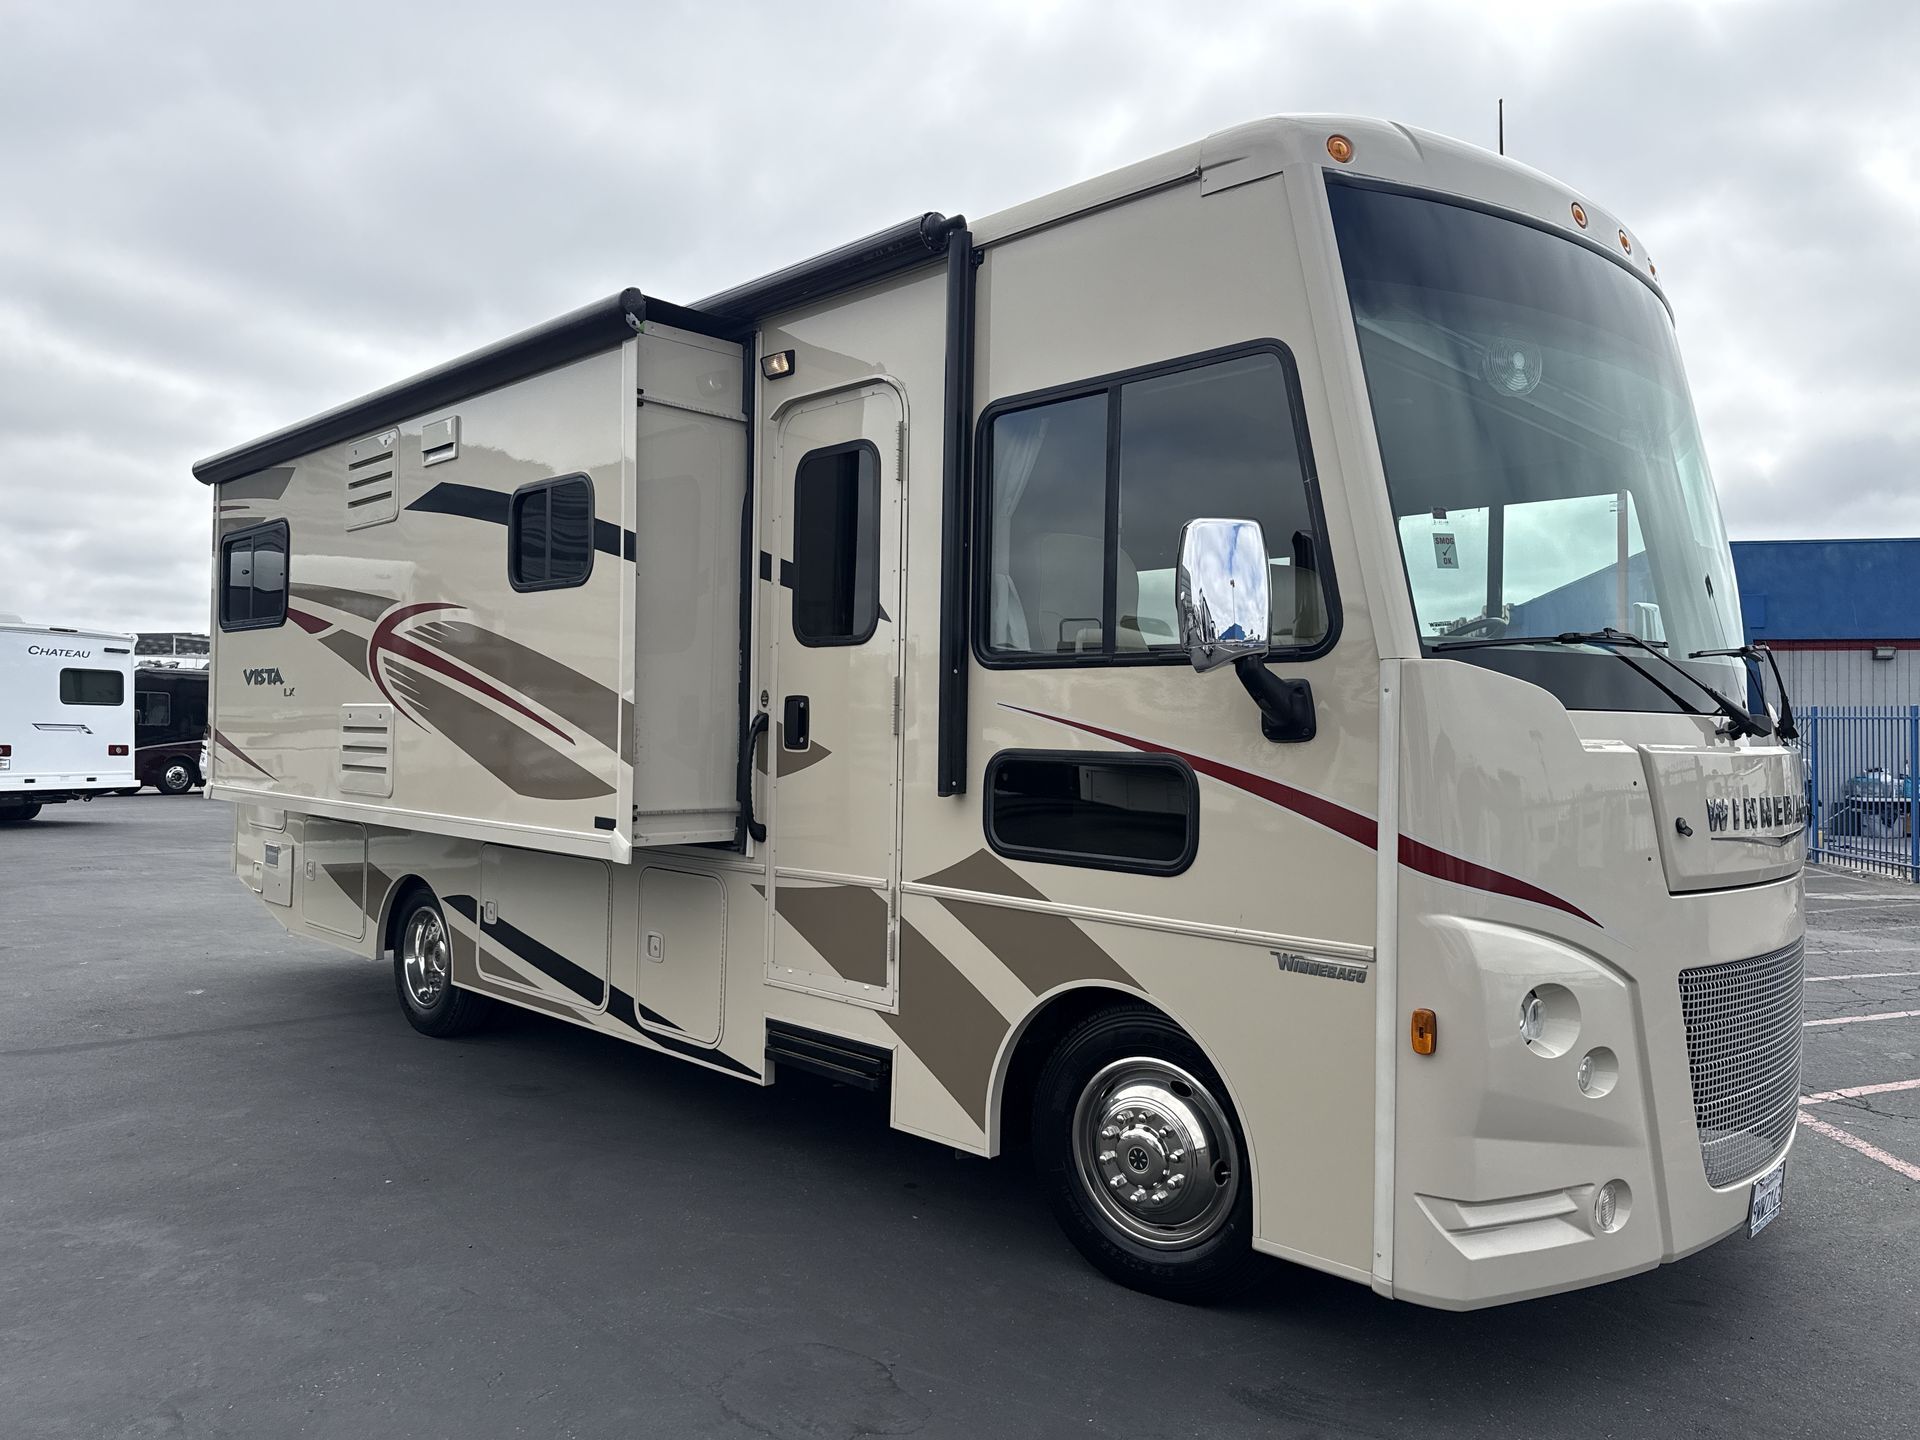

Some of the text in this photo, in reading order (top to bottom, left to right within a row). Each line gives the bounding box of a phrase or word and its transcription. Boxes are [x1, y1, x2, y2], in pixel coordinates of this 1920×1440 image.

[1435, 537, 1455, 545] SMOG
[1443, 557, 1453, 565] OK
[28, 645, 90, 659] CHATEAU
[243, 667, 284, 686] VISTA
[283, 687, 295, 697] LX
[1705, 795, 1804, 832] WINNEBA
[1270, 950, 1368, 984] WINNEBAGO
